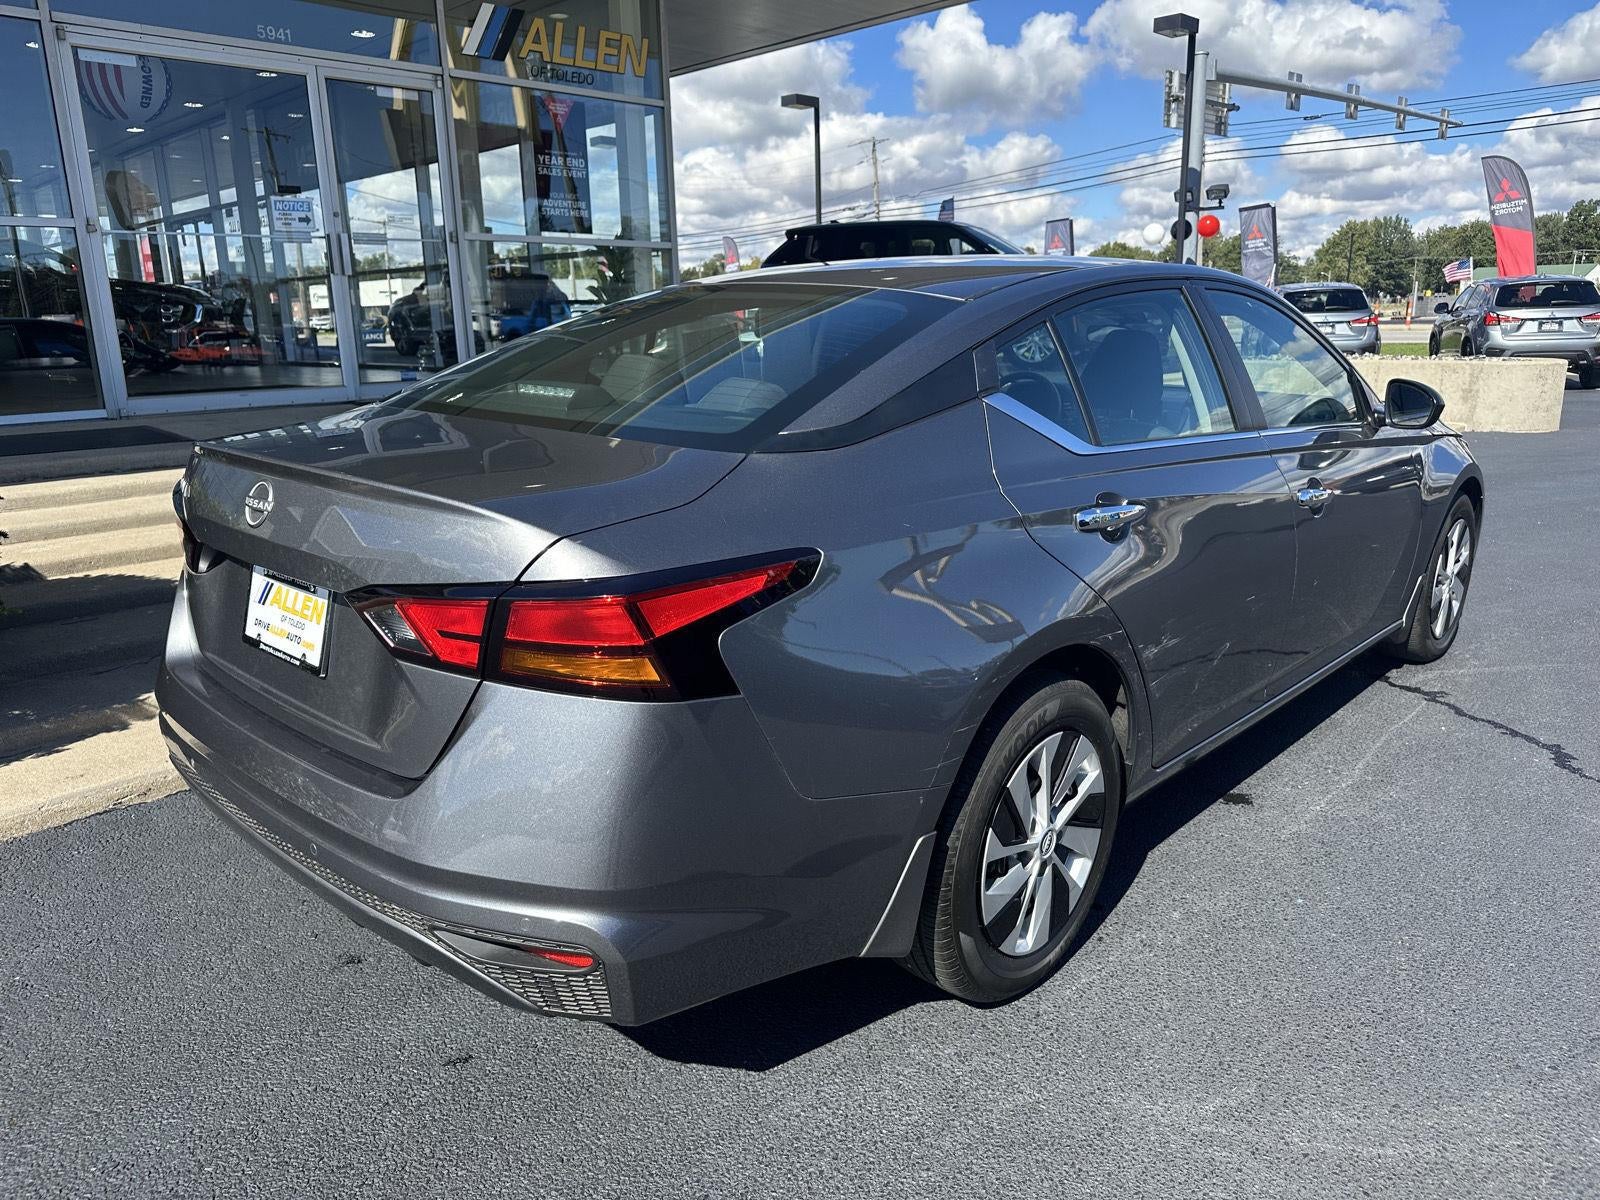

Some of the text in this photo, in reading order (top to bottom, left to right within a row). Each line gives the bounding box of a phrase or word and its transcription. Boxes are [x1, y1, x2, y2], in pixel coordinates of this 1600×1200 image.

[257, 24, 292, 43] 5941
[518, 17, 649, 78] ALLEN
[531, 65, 595, 85] OF TOLEDO
[538, 154, 586, 168] YEAR END
[537, 166, 587, 179] SALES EVENT
[275, 200, 310, 211] NOTICE
[543, 199, 587, 210] ADVENTURE
[541, 207, 589, 218] STARTS HERE
[269, 585, 326, 626] ALLEN
[280, 614, 306, 631] OF TOLEDO
